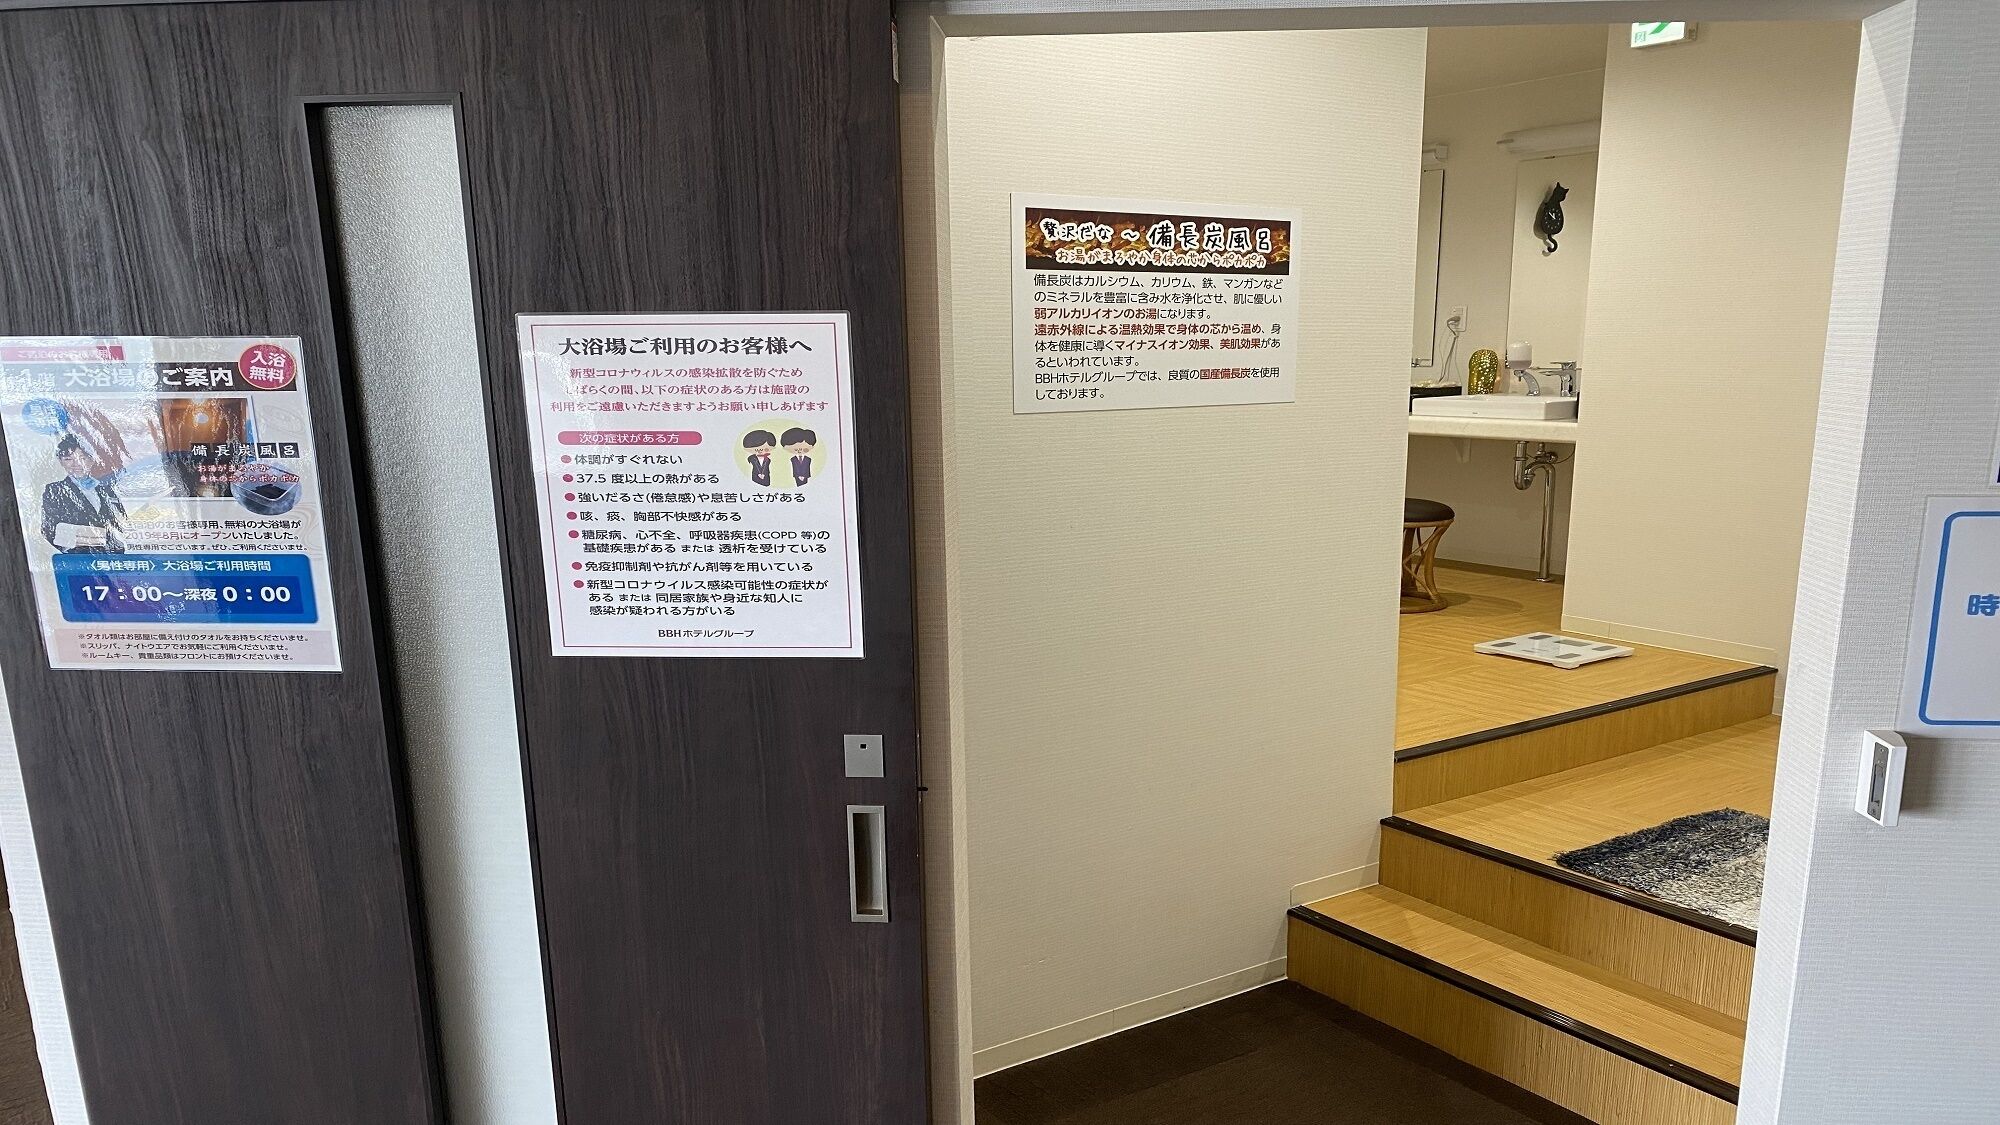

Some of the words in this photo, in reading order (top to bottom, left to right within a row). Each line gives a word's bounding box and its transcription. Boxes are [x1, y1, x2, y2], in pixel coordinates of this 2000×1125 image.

[1057, 250, 1268, 268] お湯がまろやか身体の芯からポカポカ
[1033, 274, 1284, 290] 備長炭はカルシウム、カリウム、鉄、マンガンなど
[1034, 291, 1282, 305] のミネラルを豊富に含み水を浄化させ、肌に優しい
[1034, 307, 1212, 321] 弱アルカリイオンのお湯になります。
[1034, 323, 1282, 336] 遠赤外線による温熱効果で身体の芯から温め、身
[558, 336, 813, 356] 大浴場ご利用のお客様へ
[1034, 337, 1282, 352] 体を健康に導くマイナスイオン効果、美肌効果があ
[250, 350, 287, 367] 入浴
[1035, 355, 1140, 368] るといわれています。
[249, 366, 286, 384] 無料
[1035, 367, 1280, 384] BBHホテルグループでは、良質の国産備長炭を使用
[1036, 387, 1105, 400] しております。
[550, 401, 829, 413] 利用をご遠慮いただきますようお願い申しあげます
[578, 433, 680, 445] 次の症状がある方
[191, 443, 298, 458] 備長炭風呂
[574, 453, 683, 466] 体調がすぐれない
[584, 561, 814, 573] 免疫抑制剤や抗がん剤等を用いている
[586, 579, 830, 591] 新型コロナウイルス感染可能性の症状が
[589, 605, 736, 616] 感染が疑われる方がいる
[1967, 594, 2000, 617] 時
[658, 629, 755, 638] BBHホテルグループ
